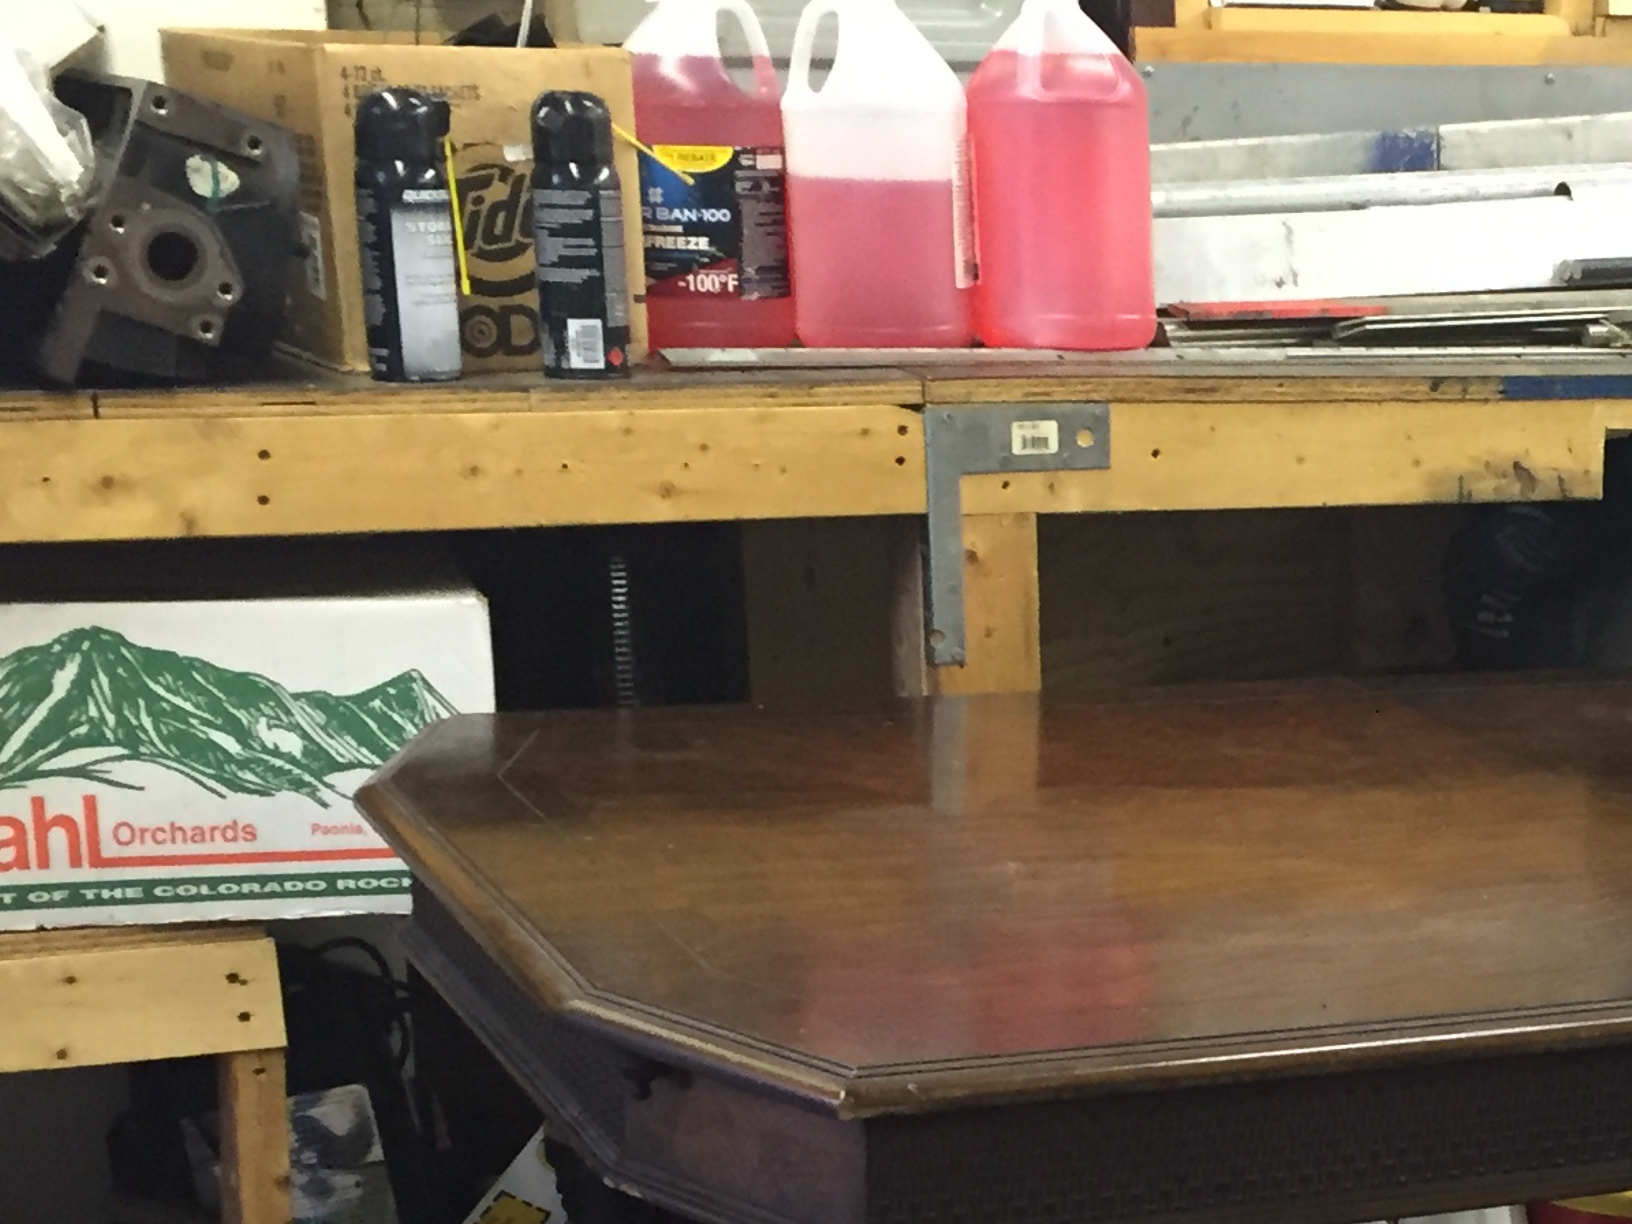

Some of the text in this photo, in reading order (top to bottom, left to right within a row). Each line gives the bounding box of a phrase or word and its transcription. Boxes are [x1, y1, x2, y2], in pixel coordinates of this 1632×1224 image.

[112, 819, 258, 847] Orchards
[27, 890, 70, 904] OF
[79, 886, 144, 901] THE
[153, 879, 328, 899] COLORADO
